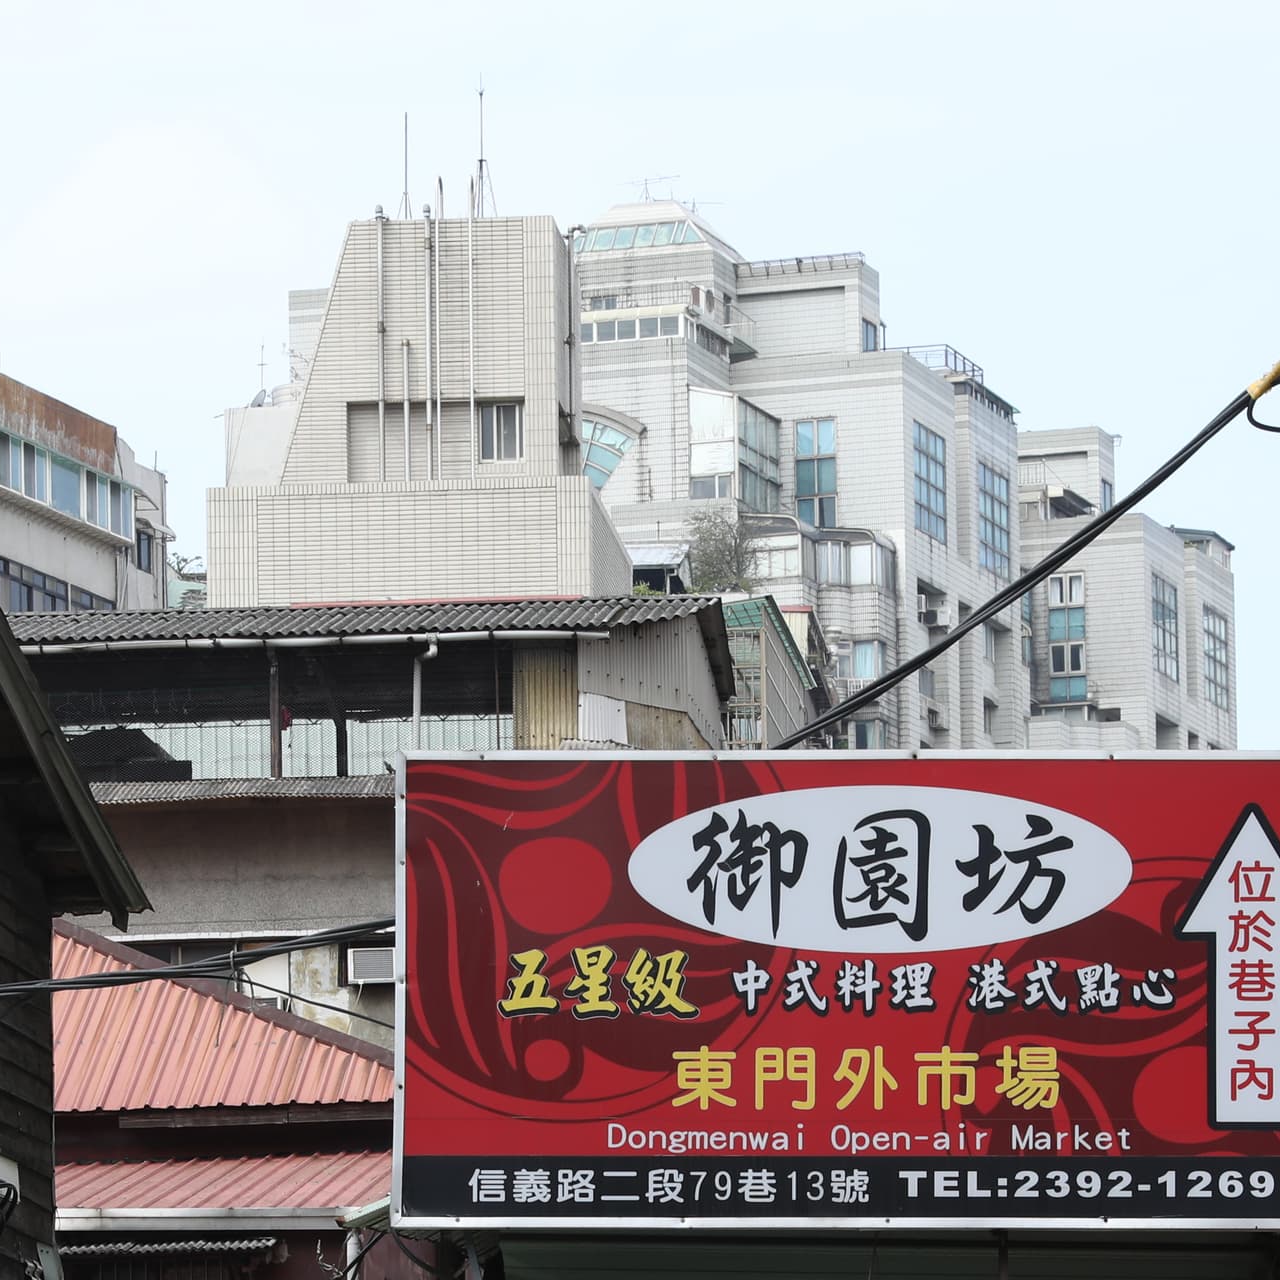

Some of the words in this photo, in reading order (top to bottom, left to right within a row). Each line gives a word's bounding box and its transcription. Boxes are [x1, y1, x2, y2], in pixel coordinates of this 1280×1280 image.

[686, 808, 1074, 941] 御園坊
[497, 945, 700, 1019] 五星級
[731, 958, 936, 1015] 中式料理
[967, 958, 1177, 1016] 港式點心
[1228, 861, 1276, 1101] 位於巷子內
[671, 1045, 1061, 1111] 東門外市場
[606, 1122, 806, 1158] Dongmenwai
[831, 1122, 986, 1158] Open-air
[1011, 1122, 1131, 1151] Market
[899, 1170, 1275, 1198] TEL:2392-1269
